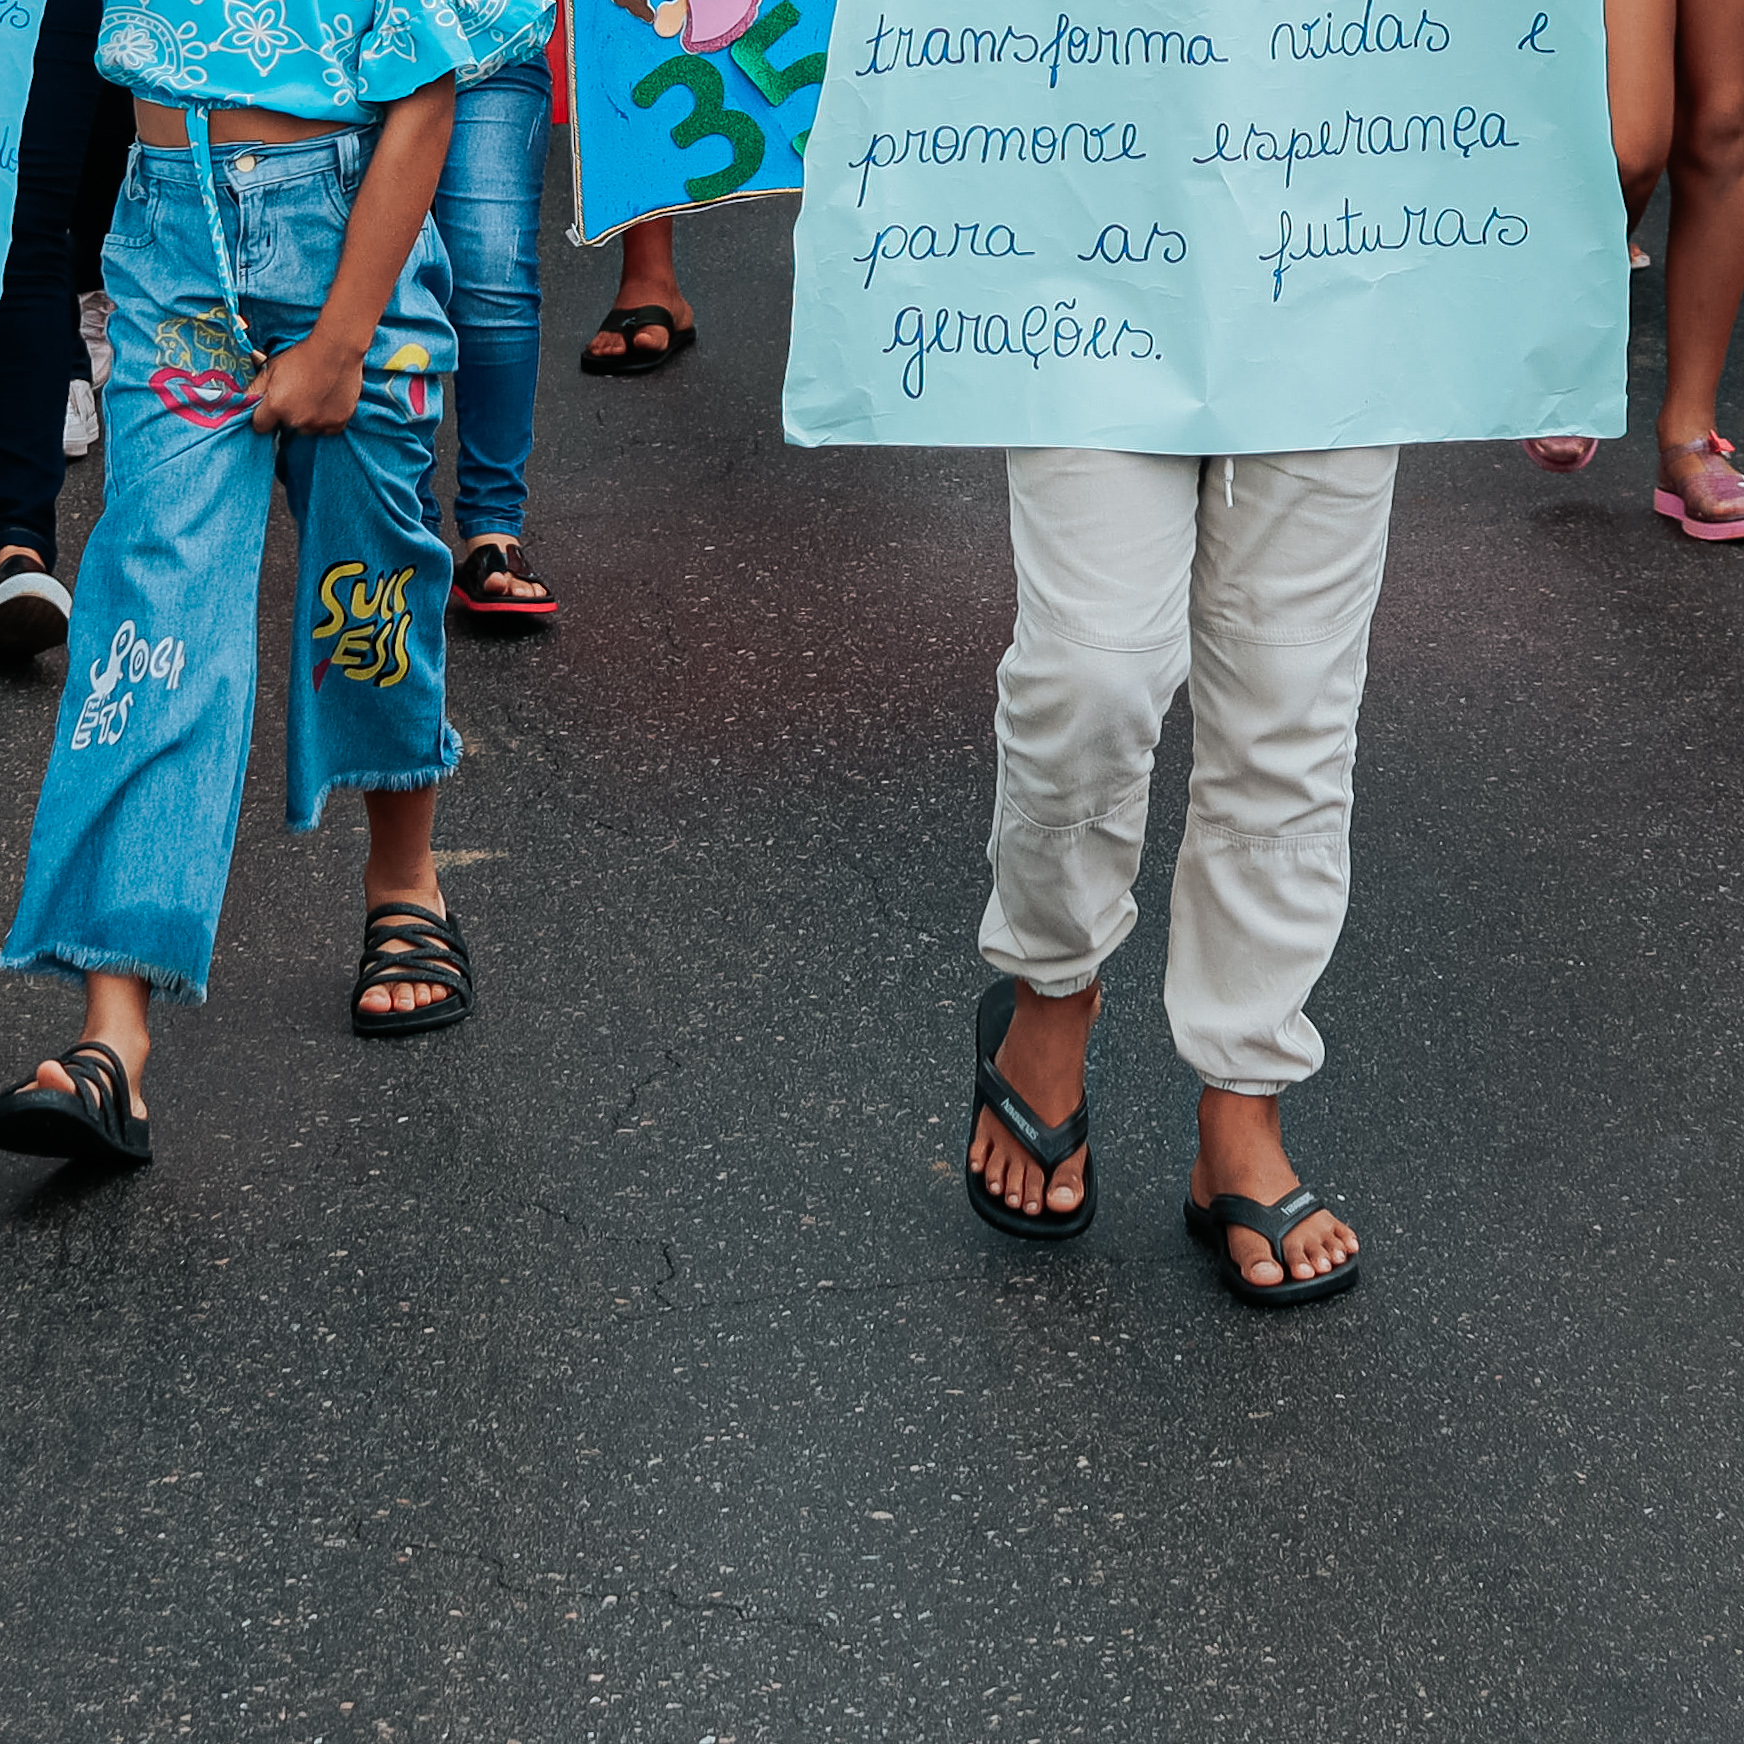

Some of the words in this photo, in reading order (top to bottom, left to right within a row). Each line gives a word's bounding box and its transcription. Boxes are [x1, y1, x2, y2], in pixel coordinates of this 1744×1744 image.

[854, 12, 1229, 90] transforma
[1516, 10, 1556, 55] e
[848, 121, 1147, 209] promove
[1191, 105, 1520, 190] esperança
[852, 221, 1036, 291] para
[1077, 220, 1188, 265] as
[1258, 196, 1529, 304] futuras
[881, 297, 1163, 399] gerações.
